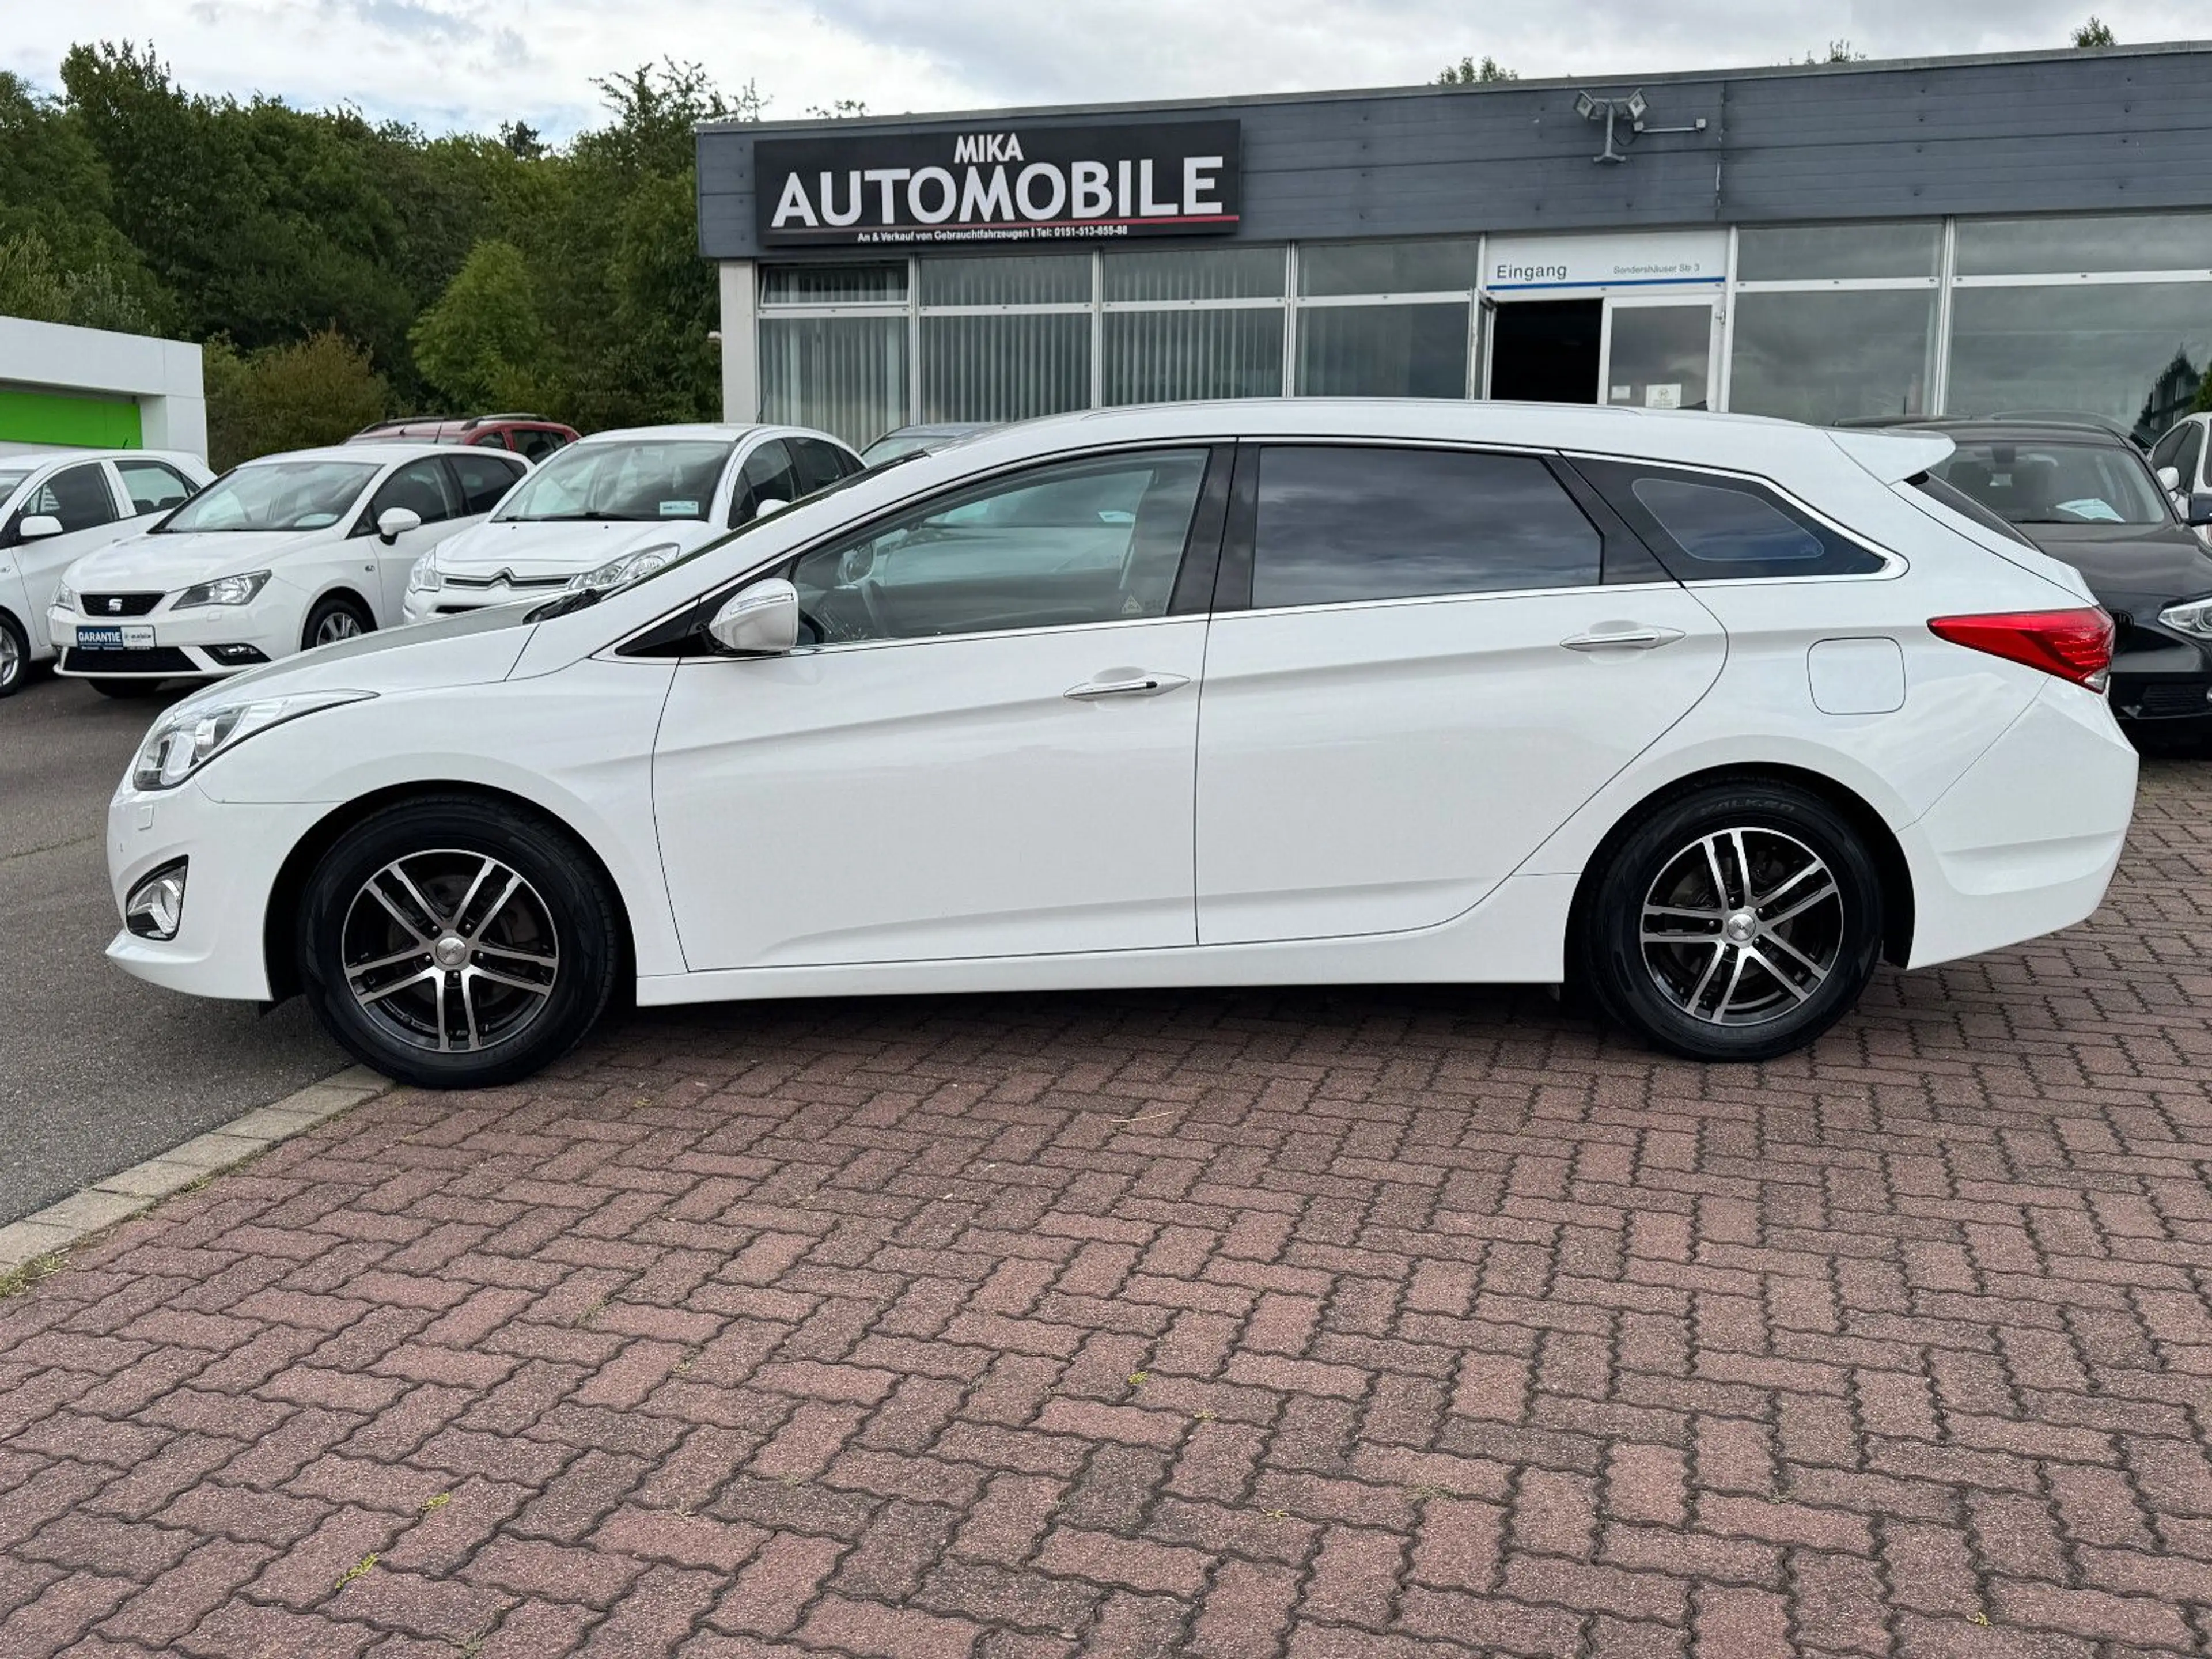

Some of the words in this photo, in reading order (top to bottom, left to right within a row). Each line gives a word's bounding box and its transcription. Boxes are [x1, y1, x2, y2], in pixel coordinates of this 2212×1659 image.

[954, 133, 1024, 164] MIKA
[771, 156, 1224, 228] AUTOMOBILE
[857, 232, 870, 242] An
[872, 232, 878, 242] &
[881, 230, 915, 242] Verkauf
[916, 233, 932, 241] von
[934, 228, 1029, 240] Gebrauchtfahrzeugen
[1036, 227, 1052, 237] Tel:
[1497, 264, 1566, 281] Eingang
[78, 631, 122, 643] GARANTIE
